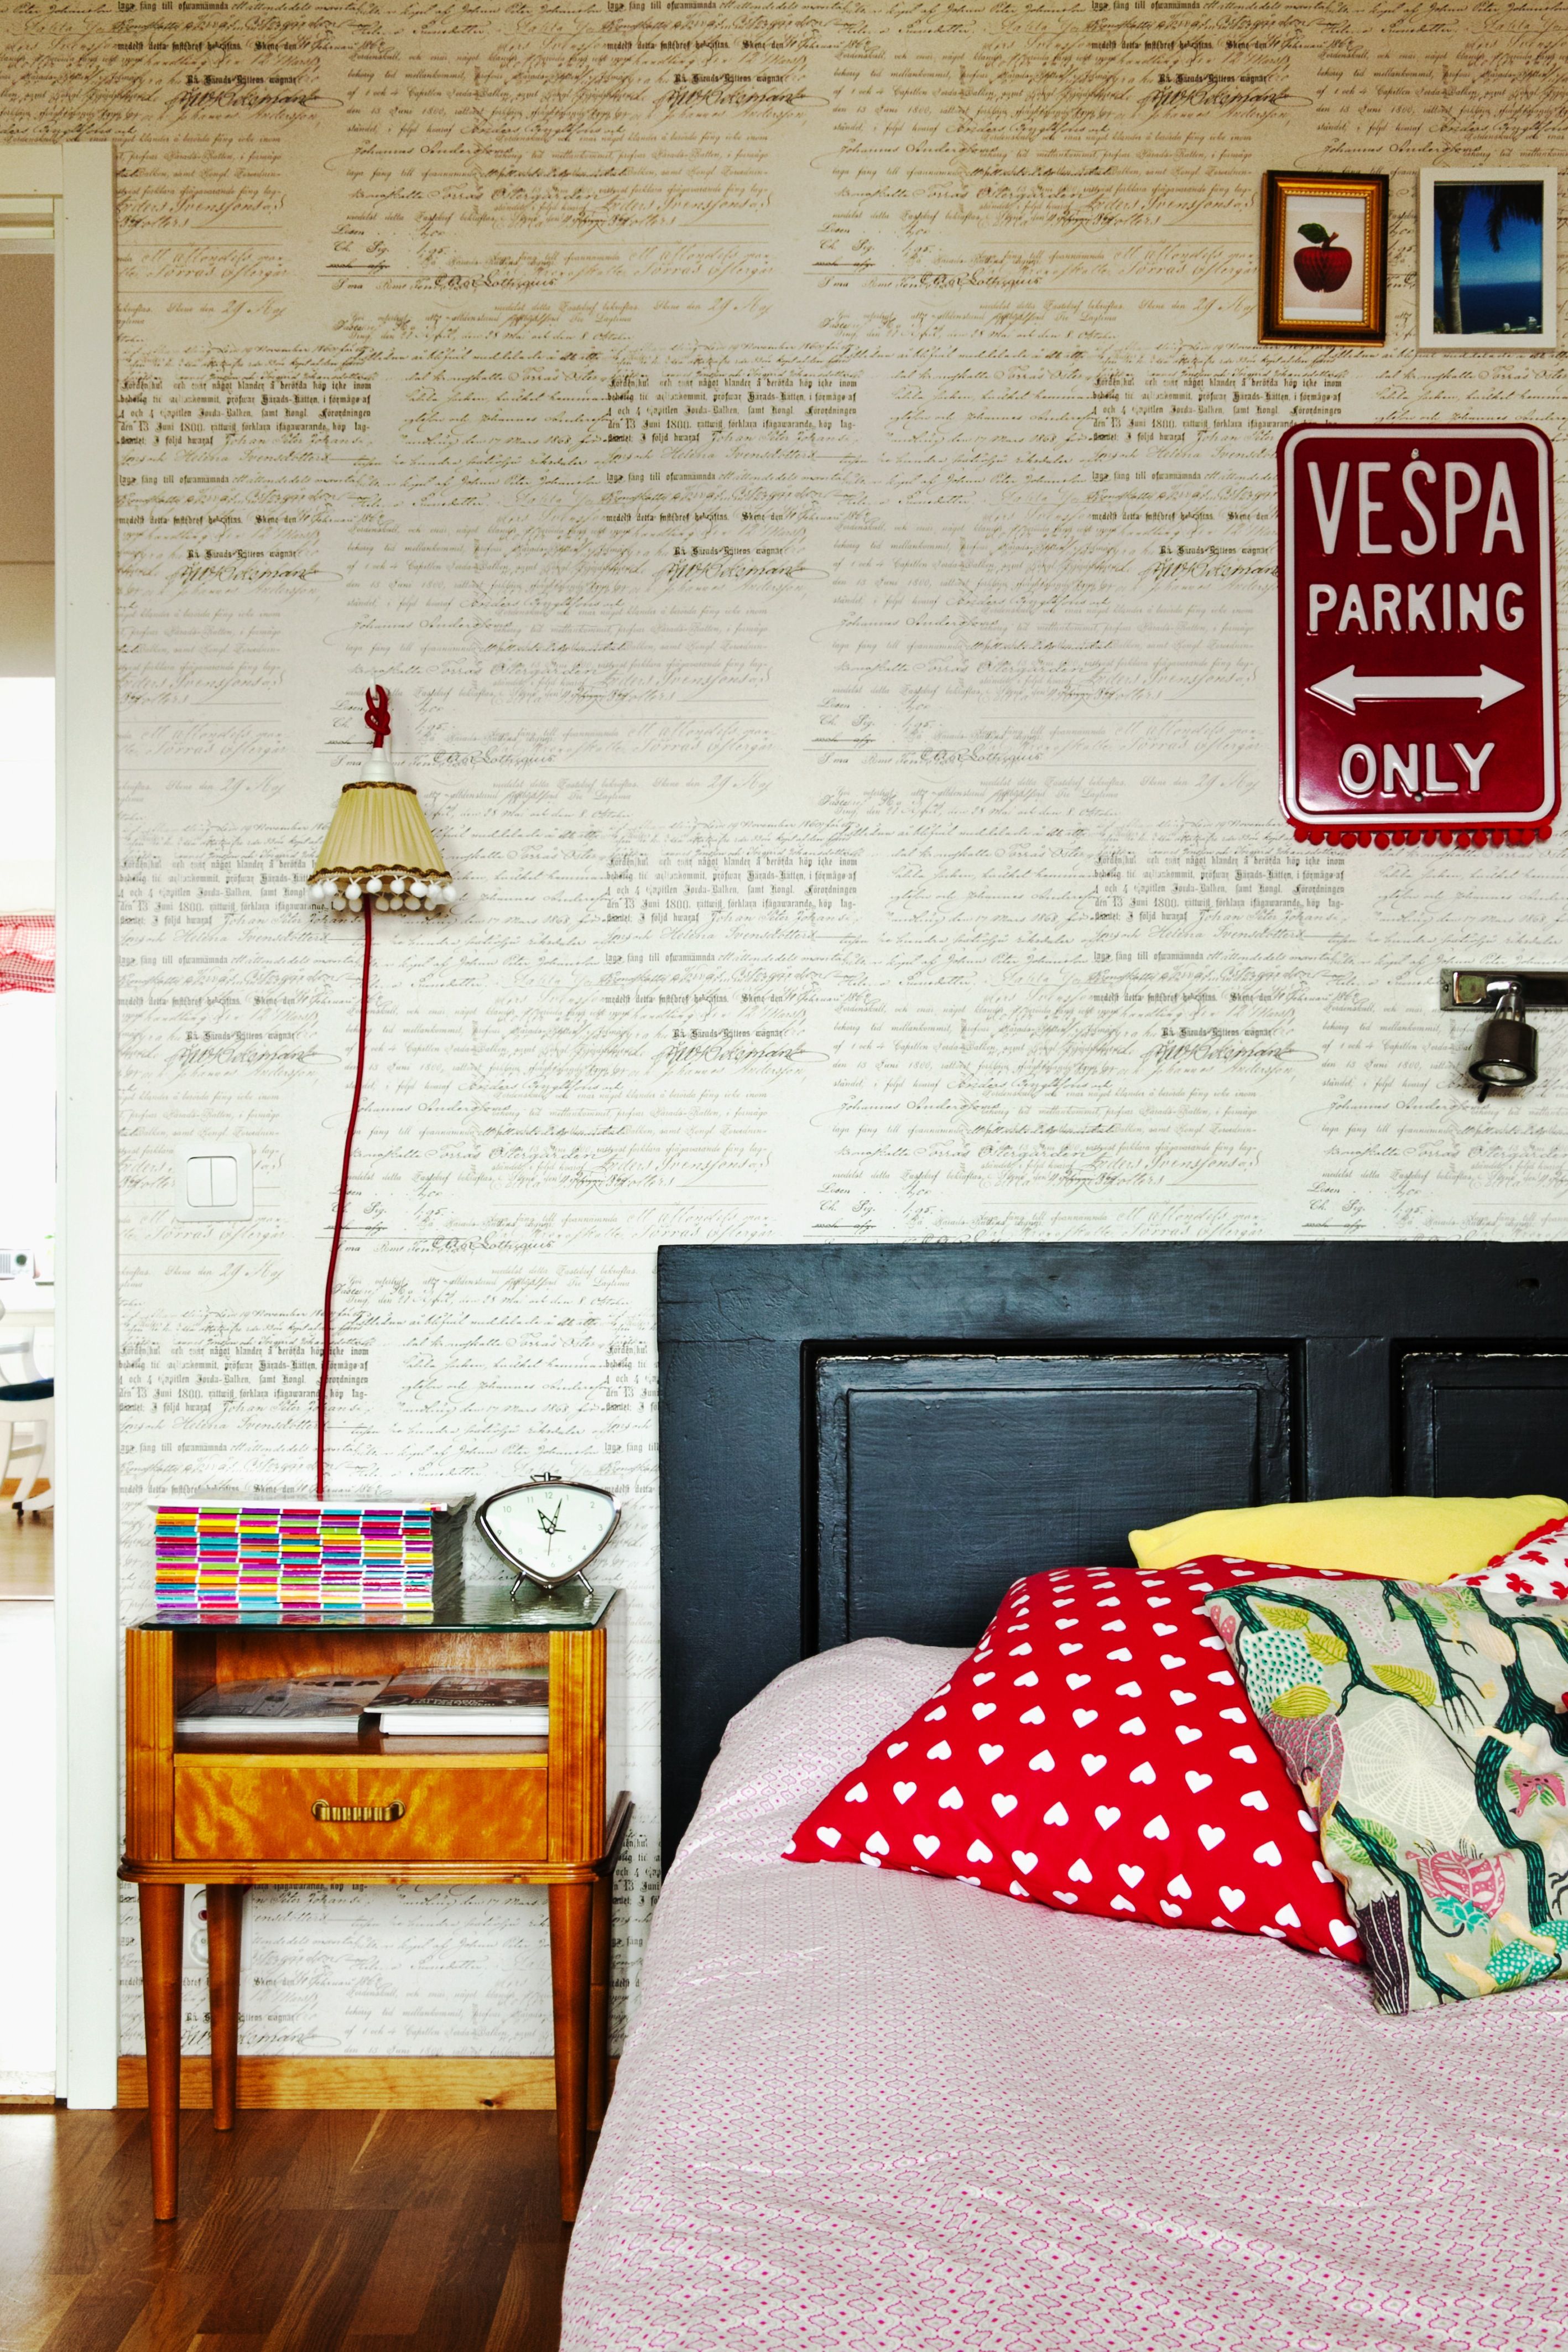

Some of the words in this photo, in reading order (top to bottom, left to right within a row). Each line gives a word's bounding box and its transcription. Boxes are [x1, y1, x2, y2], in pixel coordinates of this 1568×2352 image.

[1307, 460, 1525, 555] VESPA
[1308, 582, 1525, 632] PARKING
[1341, 742, 1495, 794] ONLY
[626, 899, 634, 909] 13
